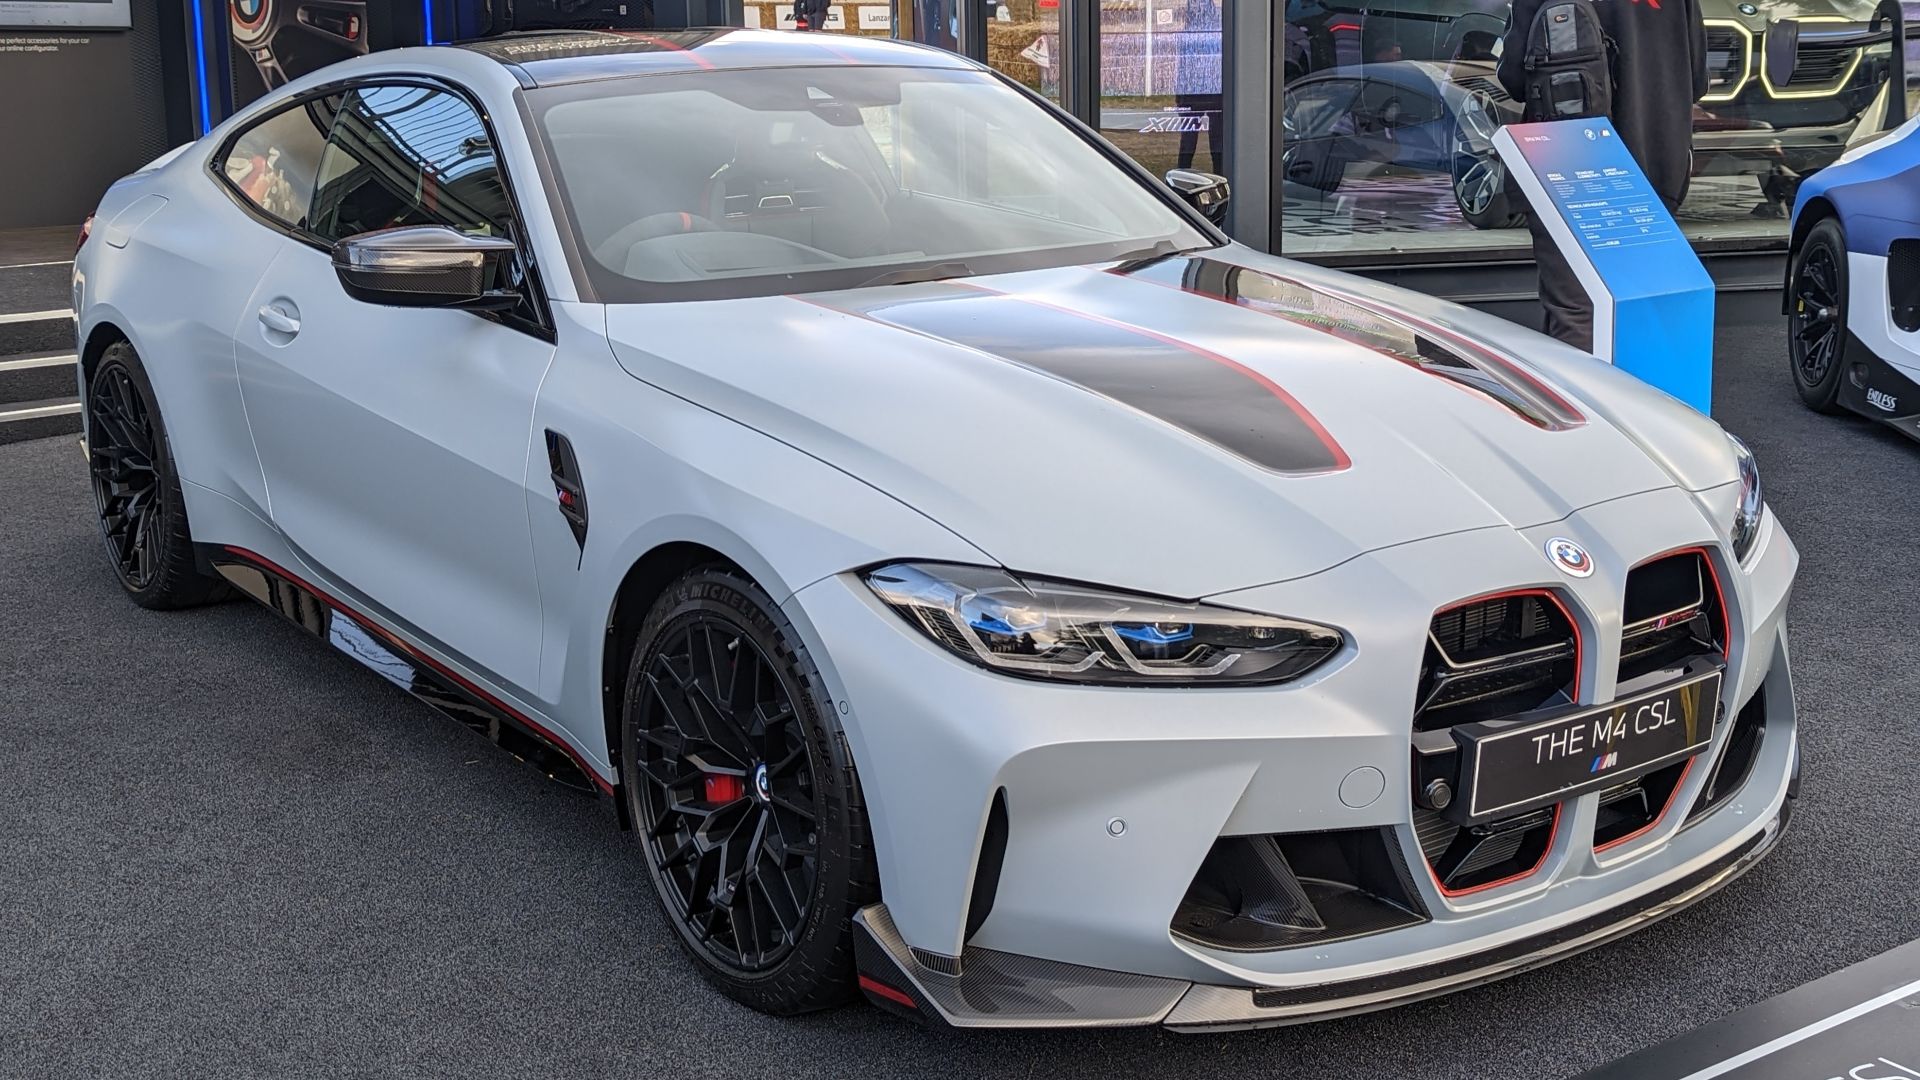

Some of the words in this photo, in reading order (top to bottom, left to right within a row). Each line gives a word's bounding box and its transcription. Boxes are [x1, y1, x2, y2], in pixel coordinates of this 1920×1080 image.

[1866, 387, 1898, 409] ENDLESS
[1532, 724, 1586, 764] THE
[1592, 711, 1627, 749] M4
[1634, 698, 1677, 735] CSL
